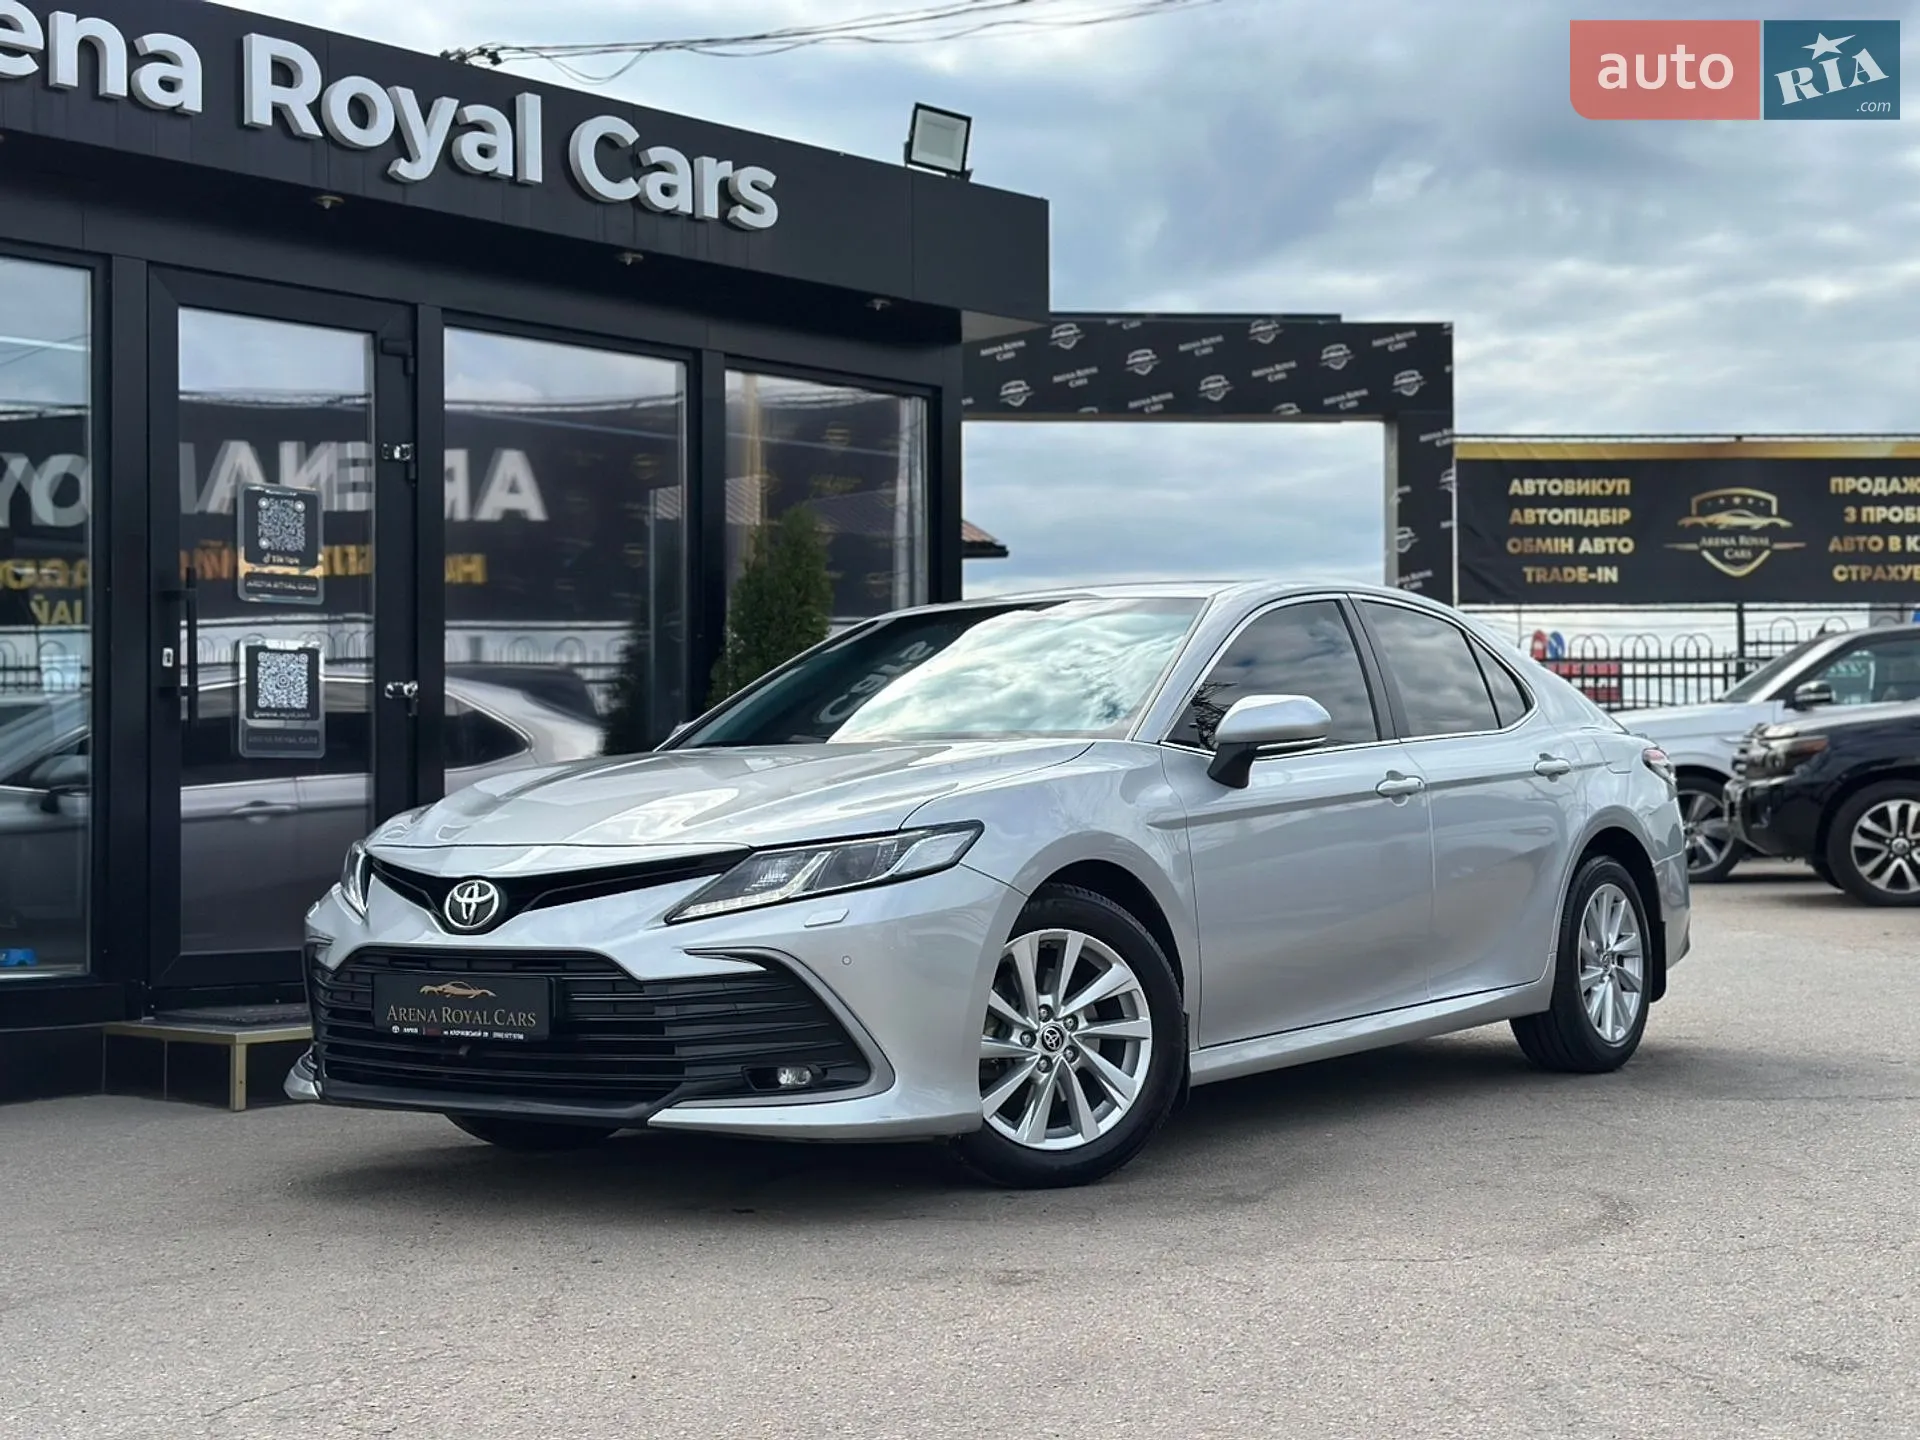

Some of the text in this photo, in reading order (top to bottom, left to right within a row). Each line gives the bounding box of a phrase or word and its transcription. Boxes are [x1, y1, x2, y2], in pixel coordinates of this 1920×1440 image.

[243, 33, 542, 184] Royal
[569, 115, 778, 230] Cars
[1508, 478, 1631, 496] АВТОВИКУП
[1829, 476, 1920, 496] ПРОДАЖ
[1509, 508, 1632, 527] АВТОПІДБІР
[1506, 537, 1635, 554] ОБМІН АВТО
[1828, 536, 1884, 552] АВТО
[1887, 535, 1902, 552] В
[1522, 566, 1619, 583] TRADE-IN
[387, 1005, 536, 1027] ARENA ROYAL CARS
